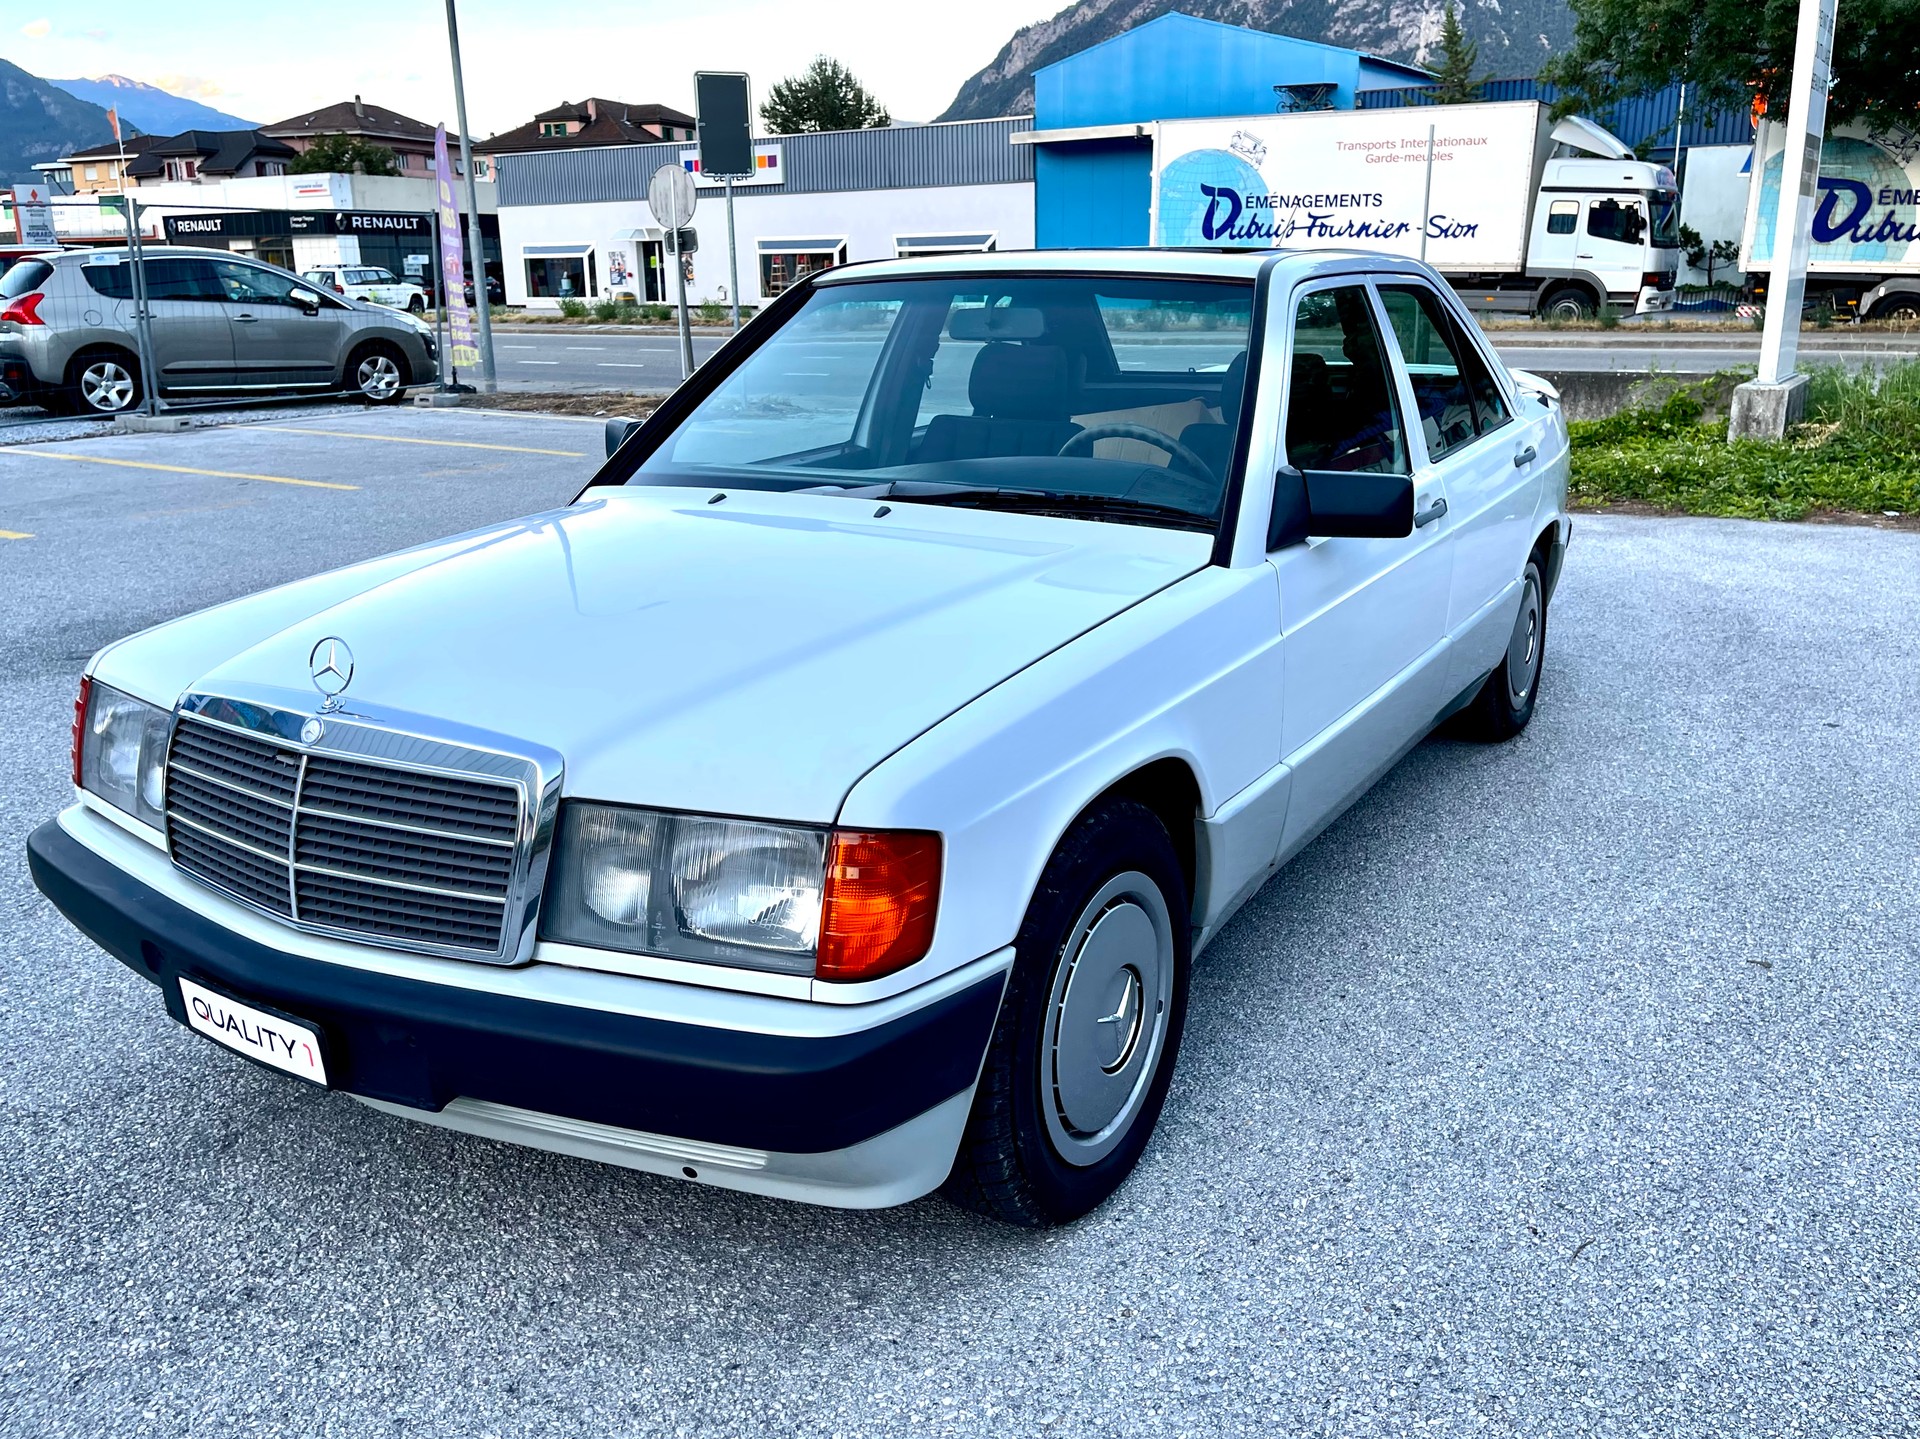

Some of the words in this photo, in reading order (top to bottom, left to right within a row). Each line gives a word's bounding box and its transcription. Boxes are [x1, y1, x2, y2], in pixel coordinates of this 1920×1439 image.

[1336, 139, 1397, 152] Transports
[1400, 136, 1488, 149] Internationaux
[1365, 151, 1454, 164] Garde-meubles
[177, 219, 222, 232] RENAULT
[351, 216, 419, 230] RENAULT
[1426, 214, 1479, 239] Sion
[192, 996, 296, 1059] QUALITY
